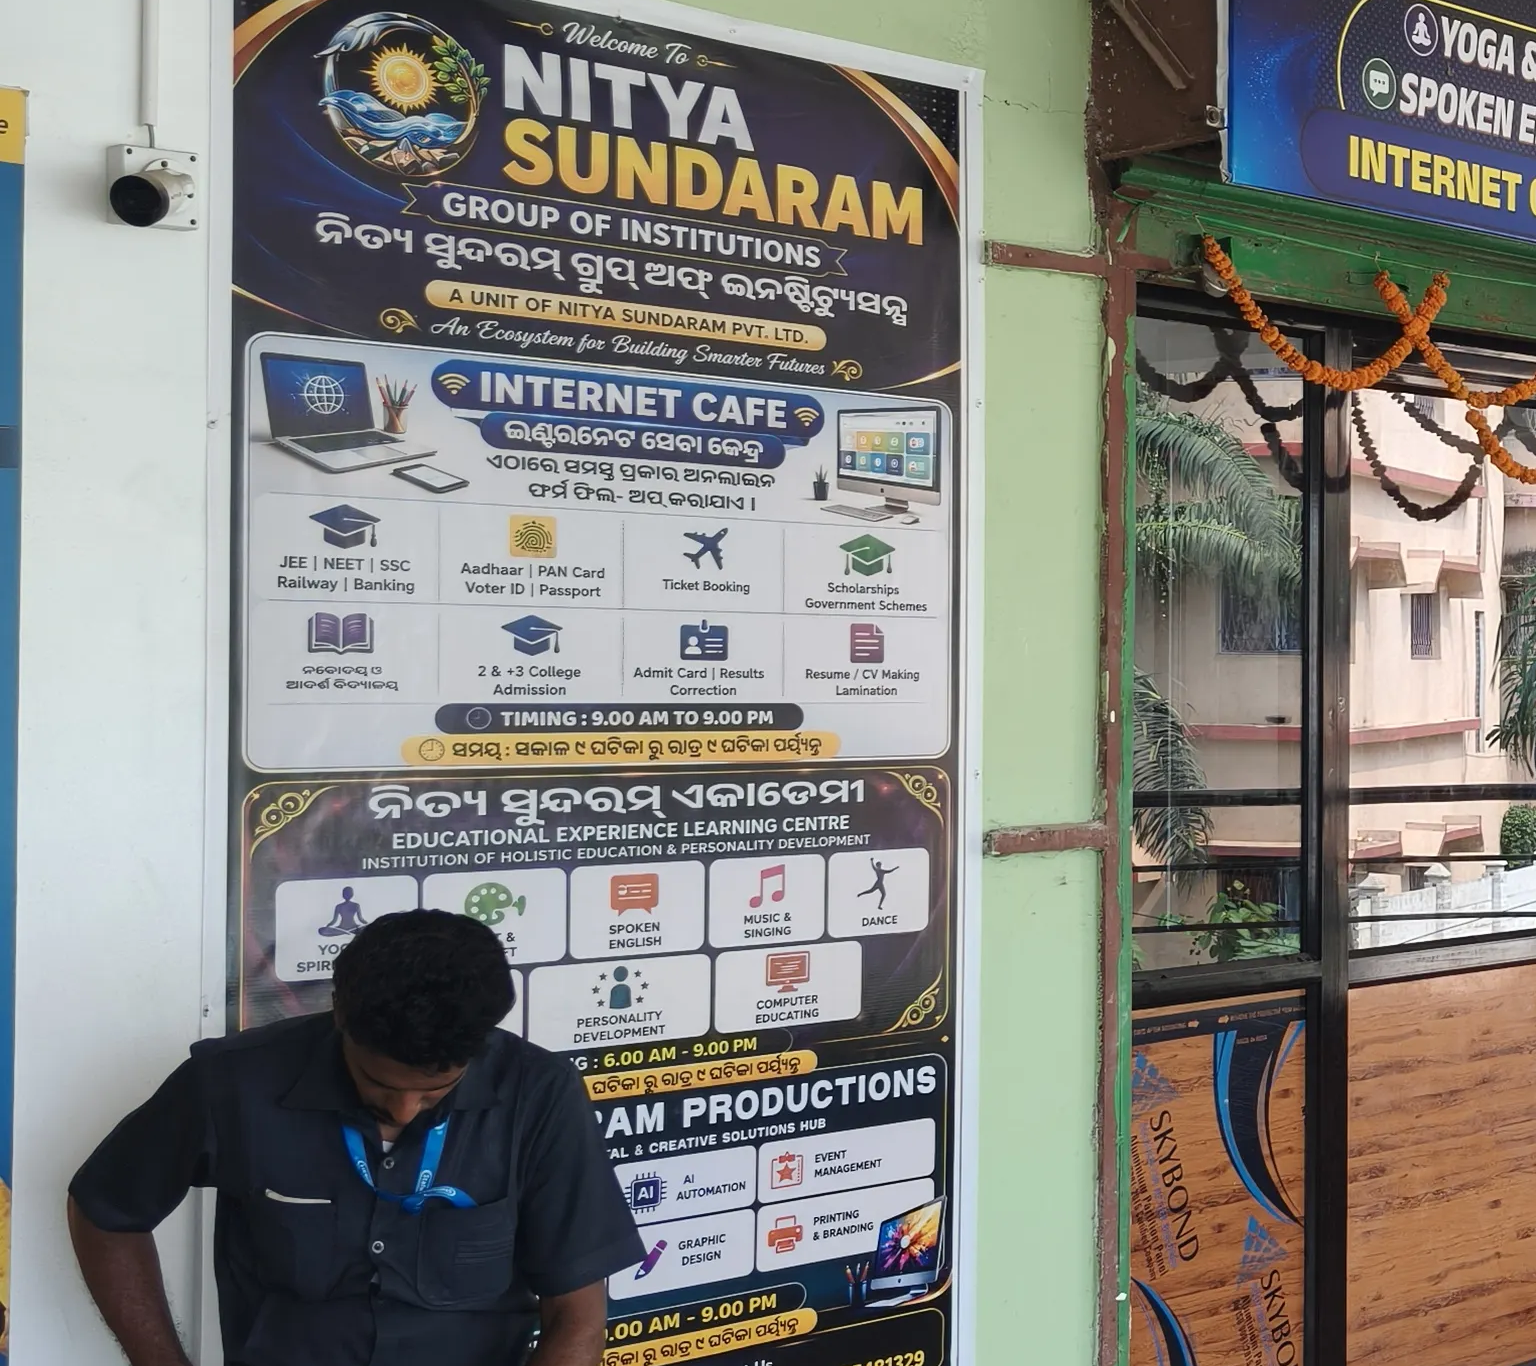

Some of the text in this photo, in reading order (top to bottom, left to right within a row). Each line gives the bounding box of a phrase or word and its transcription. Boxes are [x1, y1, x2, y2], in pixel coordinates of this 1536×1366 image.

[564, 22, 689, 65] Welcome To
[1441, 15, 1515, 77] YOGA
[504, 44, 755, 151] NITYA
[1400, 72, 1514, 138] SPOKEN
[504, 120, 923, 244] SUNDARAM
[1349, 135, 1523, 212] INTERNET
[315, 211, 412, 253] ନିତ୍ୟ
[442, 193, 821, 267] GROUP OF INSTITUTIONS
[430, 317, 826, 375] An Ecosystem for Building Smarter Futures
[480, 371, 787, 428] INTERNET CAFE
[279, 556, 411, 572] JEE NEET SSC
[461, 563, 605, 579] Aadhaar PAN Card
[278, 576, 415, 594] Railway Banking
[465, 582, 601, 599] Voter ID Passport
[663, 579, 750, 595] Ticket Booking
[828, 583, 899, 596] Scholarships
[805, 598, 927, 612] Government Schemes
[529, 666, 581, 680] College
[633, 667, 765, 679] Admit Card Results
[805, 669, 920, 681] Resume CV Making
[493, 684, 567, 696] Admission
[670, 685, 737, 696] Correction
[836, 685, 898, 696] Lamination
[369, 785, 487, 819] ନିତ୍ୟ
[672, 779, 865, 809] ଏକାଡେମୀ
[393, 815, 850, 849] EDUCATIONAL EXPERIENCE LEARNING CENTRE
[744, 913, 781, 924] MUSIC
[862, 916, 898, 927] DANCE
[609, 922, 661, 935] SPOKEN
[744, 926, 792, 938] SINGING
[609, 937, 662, 949] ENGLISH
[756, 995, 819, 1010] COMPUTER
[576, 1010, 663, 1028] PERSONALITY
[755, 1009, 820, 1024] EDUCATING
[573, 1024, 666, 1044] DEVELOPMENT
[683, 1065, 937, 1129] PRODUCTIONS
[649, 1118, 827, 1155] CREATIVE SOLUTIONS HUB
[815, 1150, 847, 1164] EVENT
[814, 1159, 882, 1178] MANAGEMENT
[676, 1181, 746, 1201] AUTOMATION
[1149, 1110, 1201, 1264] SKYBOND
[813, 1210, 860, 1226] PRINTING
[813, 1221, 875, 1241] & BRANDING
[678, 1233, 726, 1252] GRAPHIC
[681, 1250, 721, 1266] DESIGN
